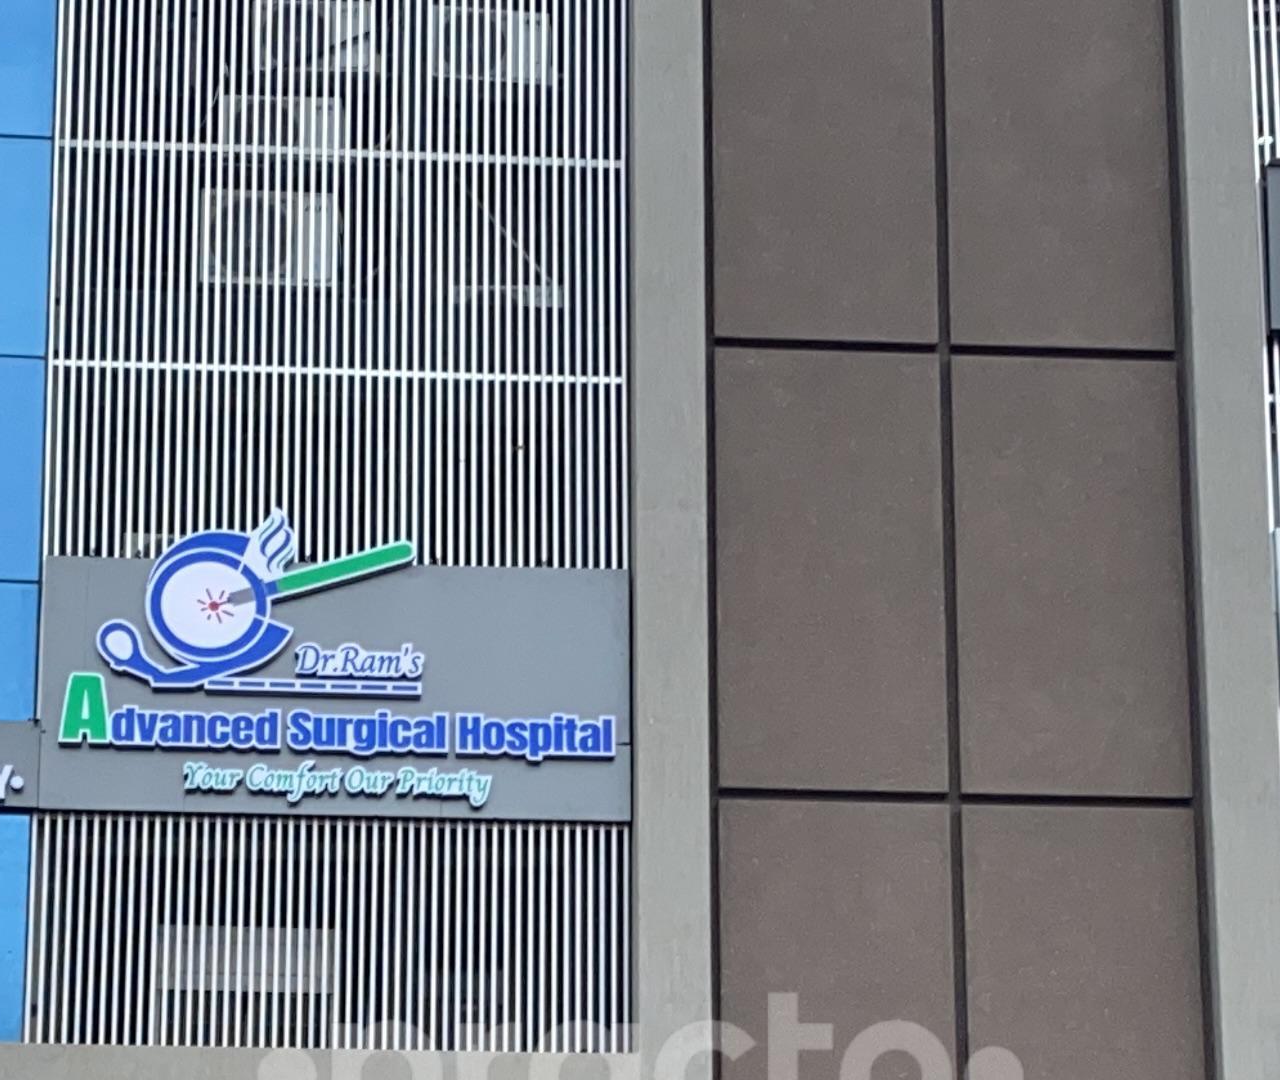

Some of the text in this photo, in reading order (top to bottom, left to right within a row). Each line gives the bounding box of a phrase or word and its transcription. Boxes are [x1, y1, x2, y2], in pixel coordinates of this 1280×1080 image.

[58, 672, 616, 762] Advanced Surgical Hospital
[183, 760, 492, 807] Your Comfort Our Priority
